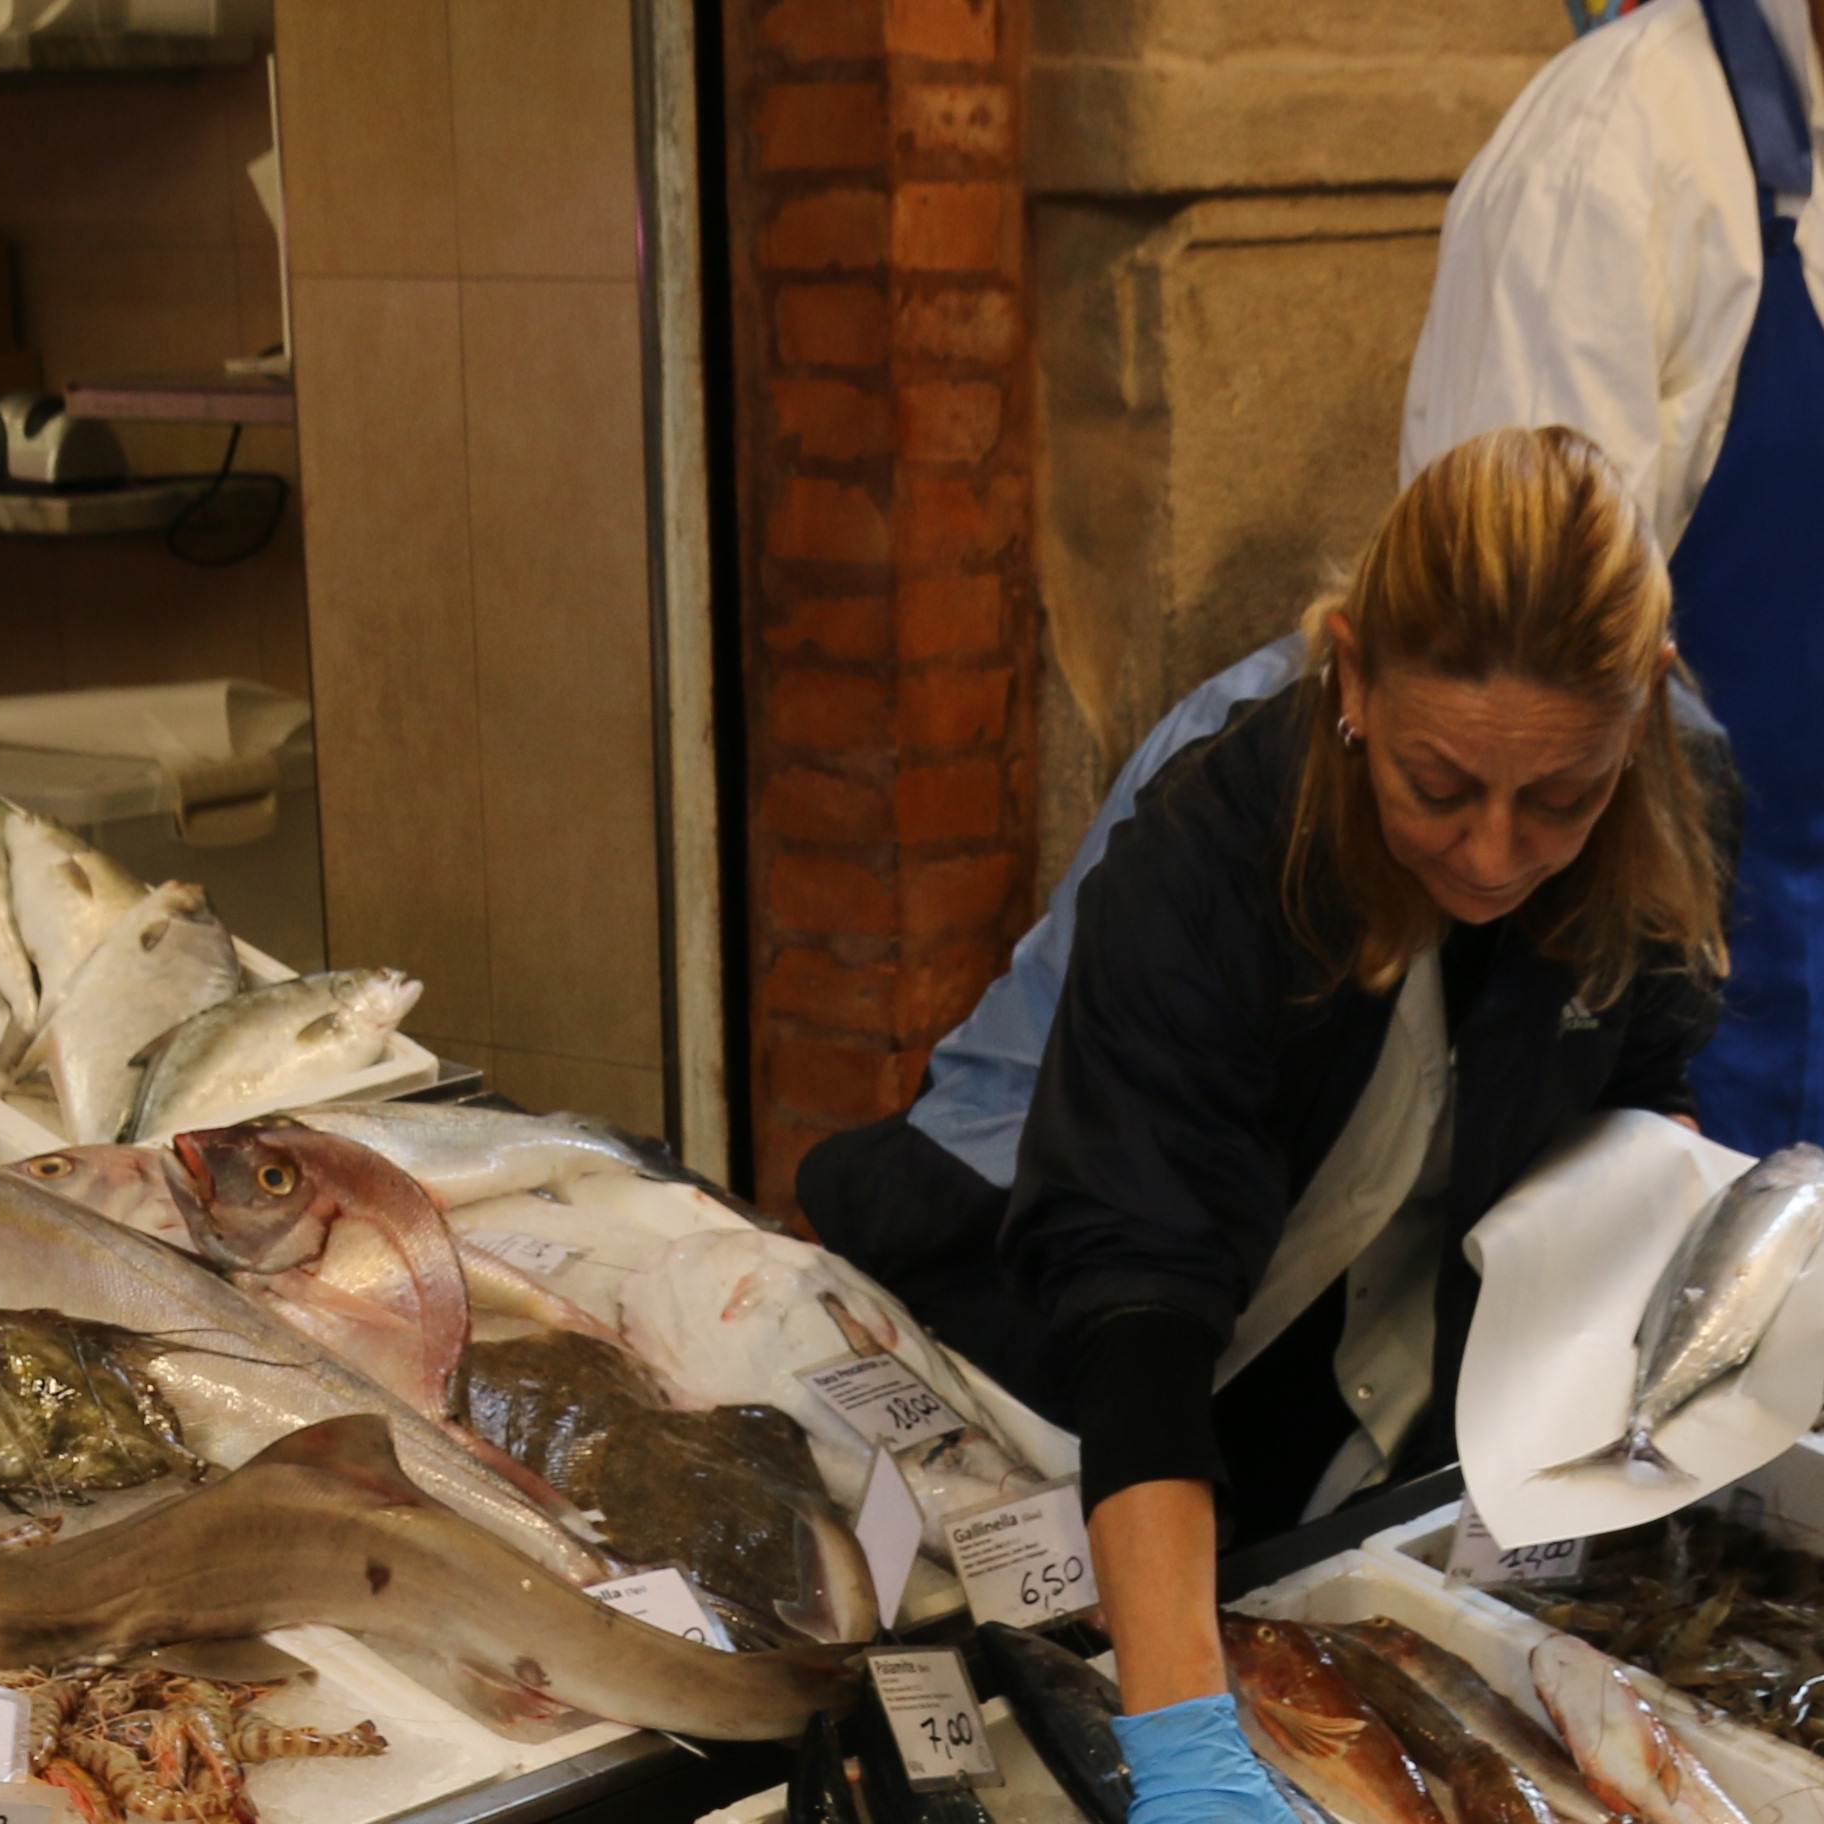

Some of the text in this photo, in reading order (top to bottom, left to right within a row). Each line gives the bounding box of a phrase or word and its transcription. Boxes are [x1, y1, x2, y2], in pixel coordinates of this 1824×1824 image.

[953, 1514, 1018, 1543] Gallinella
[1021, 1556, 1084, 1610] 6,50
[920, 1712, 973, 1760] 7,00
